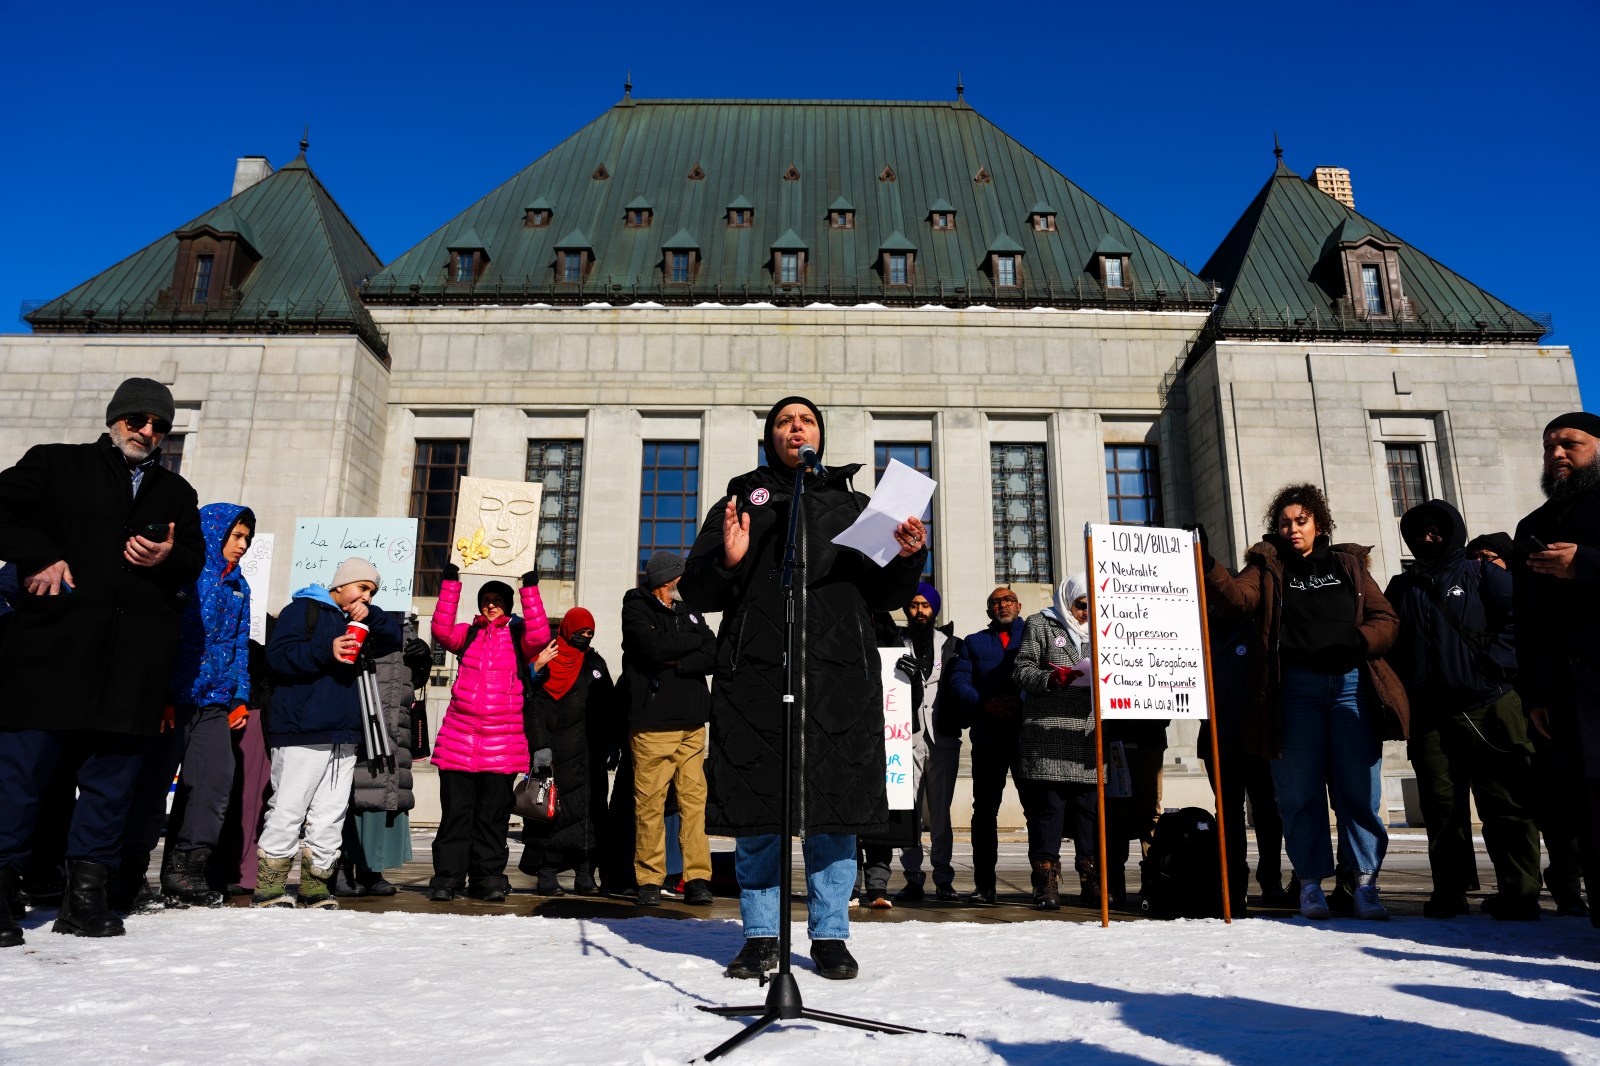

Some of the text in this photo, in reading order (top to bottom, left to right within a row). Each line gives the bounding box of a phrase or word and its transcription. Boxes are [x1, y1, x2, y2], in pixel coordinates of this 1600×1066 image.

[311, 523, 329, 547] La
[1112, 531, 1132, 552] LOI
[295, 557, 328, 570] n'est
[1111, 561, 1159, 577] Neutralité
[1112, 577, 1190, 594] Discrimination
[1114, 622, 1178, 646] Oppression
[1112, 652, 1144, 667] Clause
[1113, 673, 1197, 692] Clause D'impunité
[1109, 697, 1131, 710] NON
[1143, 698, 1153, 710] LA
